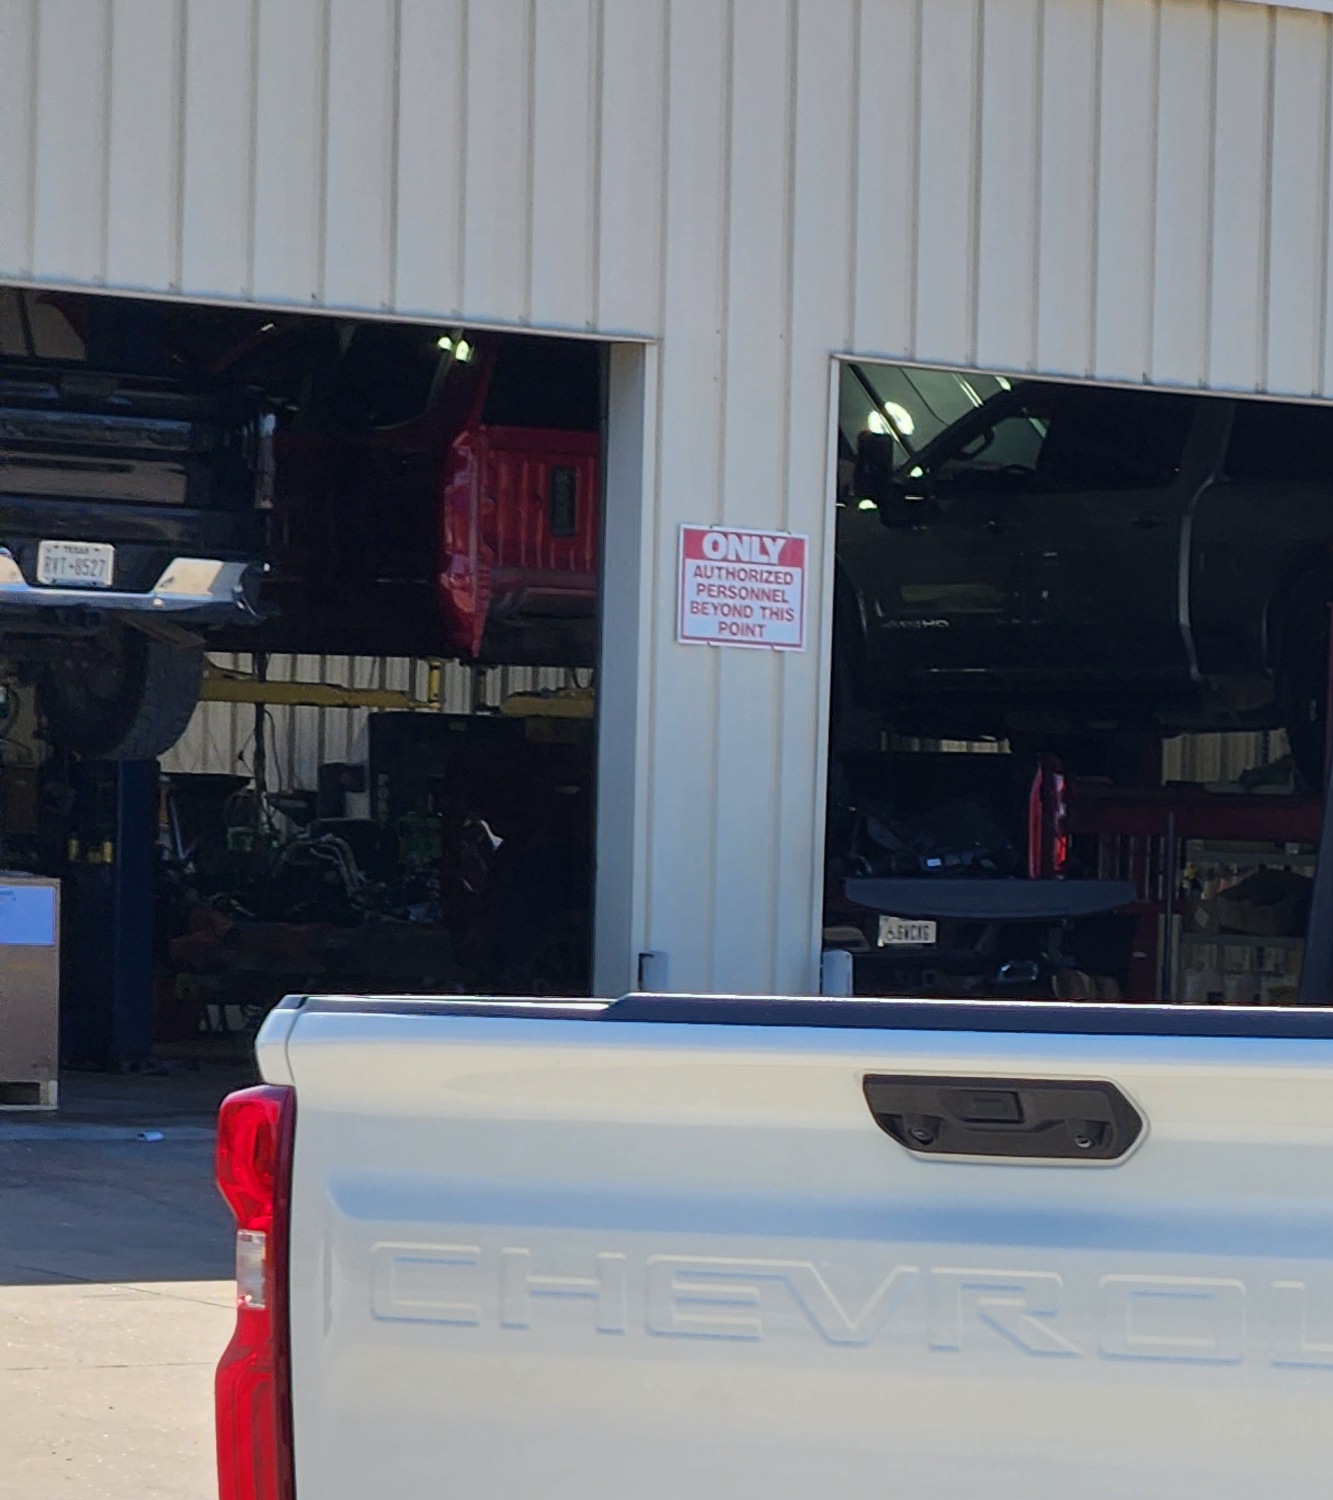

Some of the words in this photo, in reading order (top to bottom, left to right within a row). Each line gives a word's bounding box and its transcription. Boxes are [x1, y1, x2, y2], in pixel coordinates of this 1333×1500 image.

[702, 532, 786, 565] ONLY
[694, 565, 793, 585] AUTHORIZED
[696, 583, 789, 603] PERSONNEL
[690, 600, 753, 618] BEYOND
[760, 606, 795, 622] THIS
[718, 621, 767, 638] POINT
